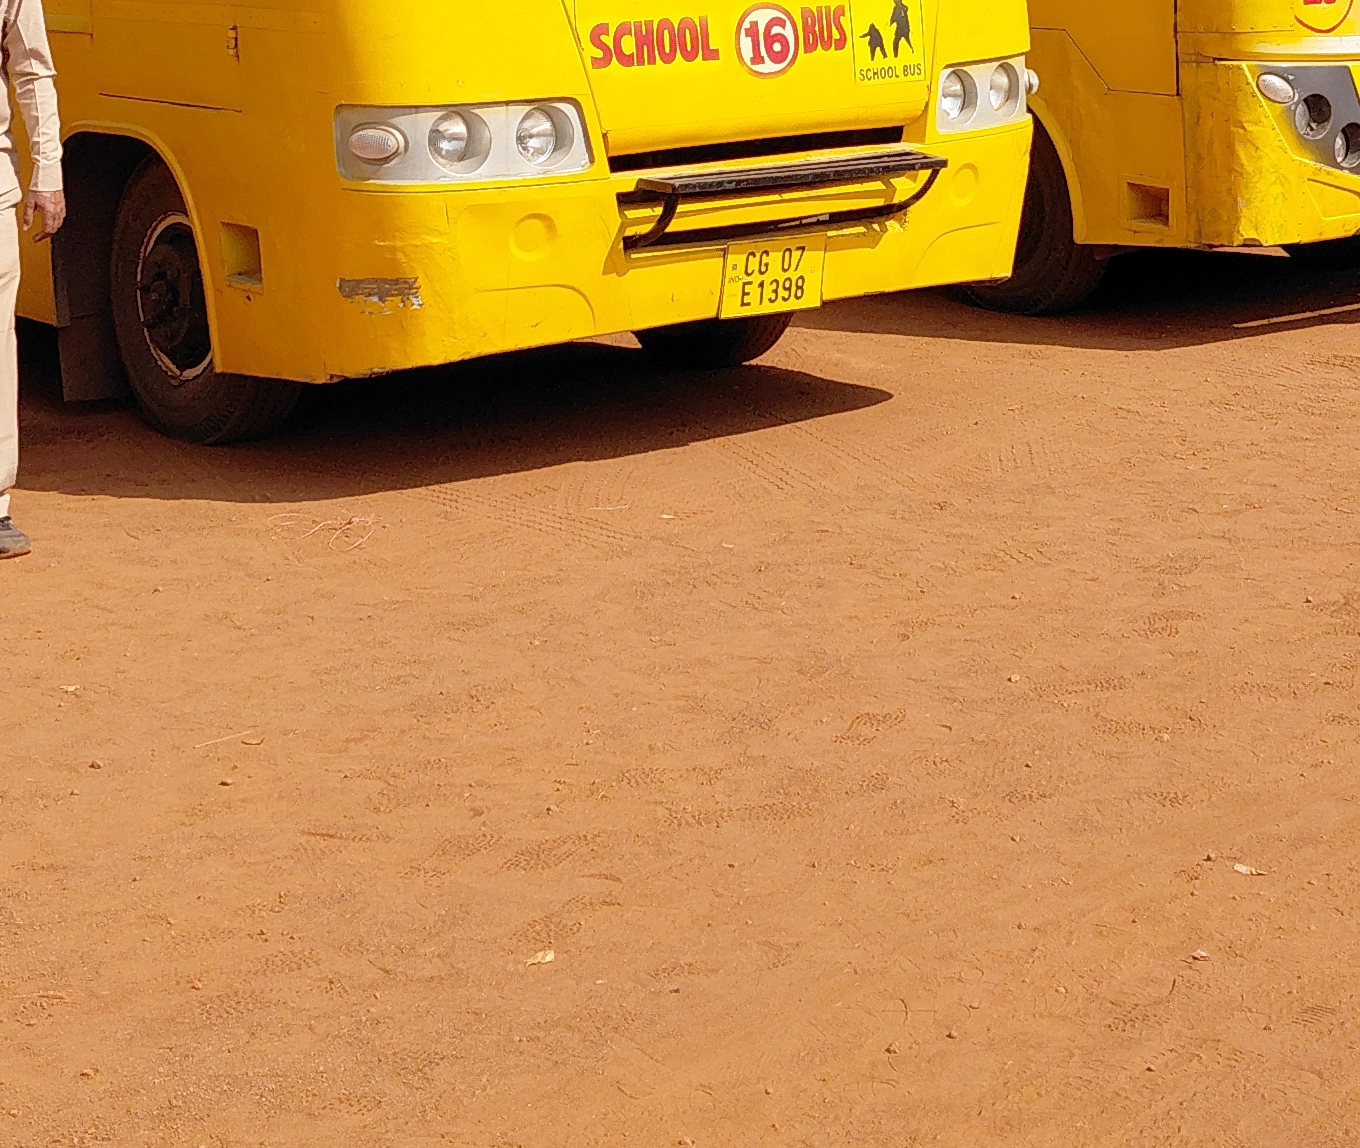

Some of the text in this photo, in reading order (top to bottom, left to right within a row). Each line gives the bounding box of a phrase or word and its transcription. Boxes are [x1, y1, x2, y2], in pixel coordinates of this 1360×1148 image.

[589, 4, 847, 69] SCHOOL 16 BUS
[859, 62, 922, 82] SCHOOL BUS
[744, 245, 807, 277] CG 07
[739, 274, 806, 308] E1398
